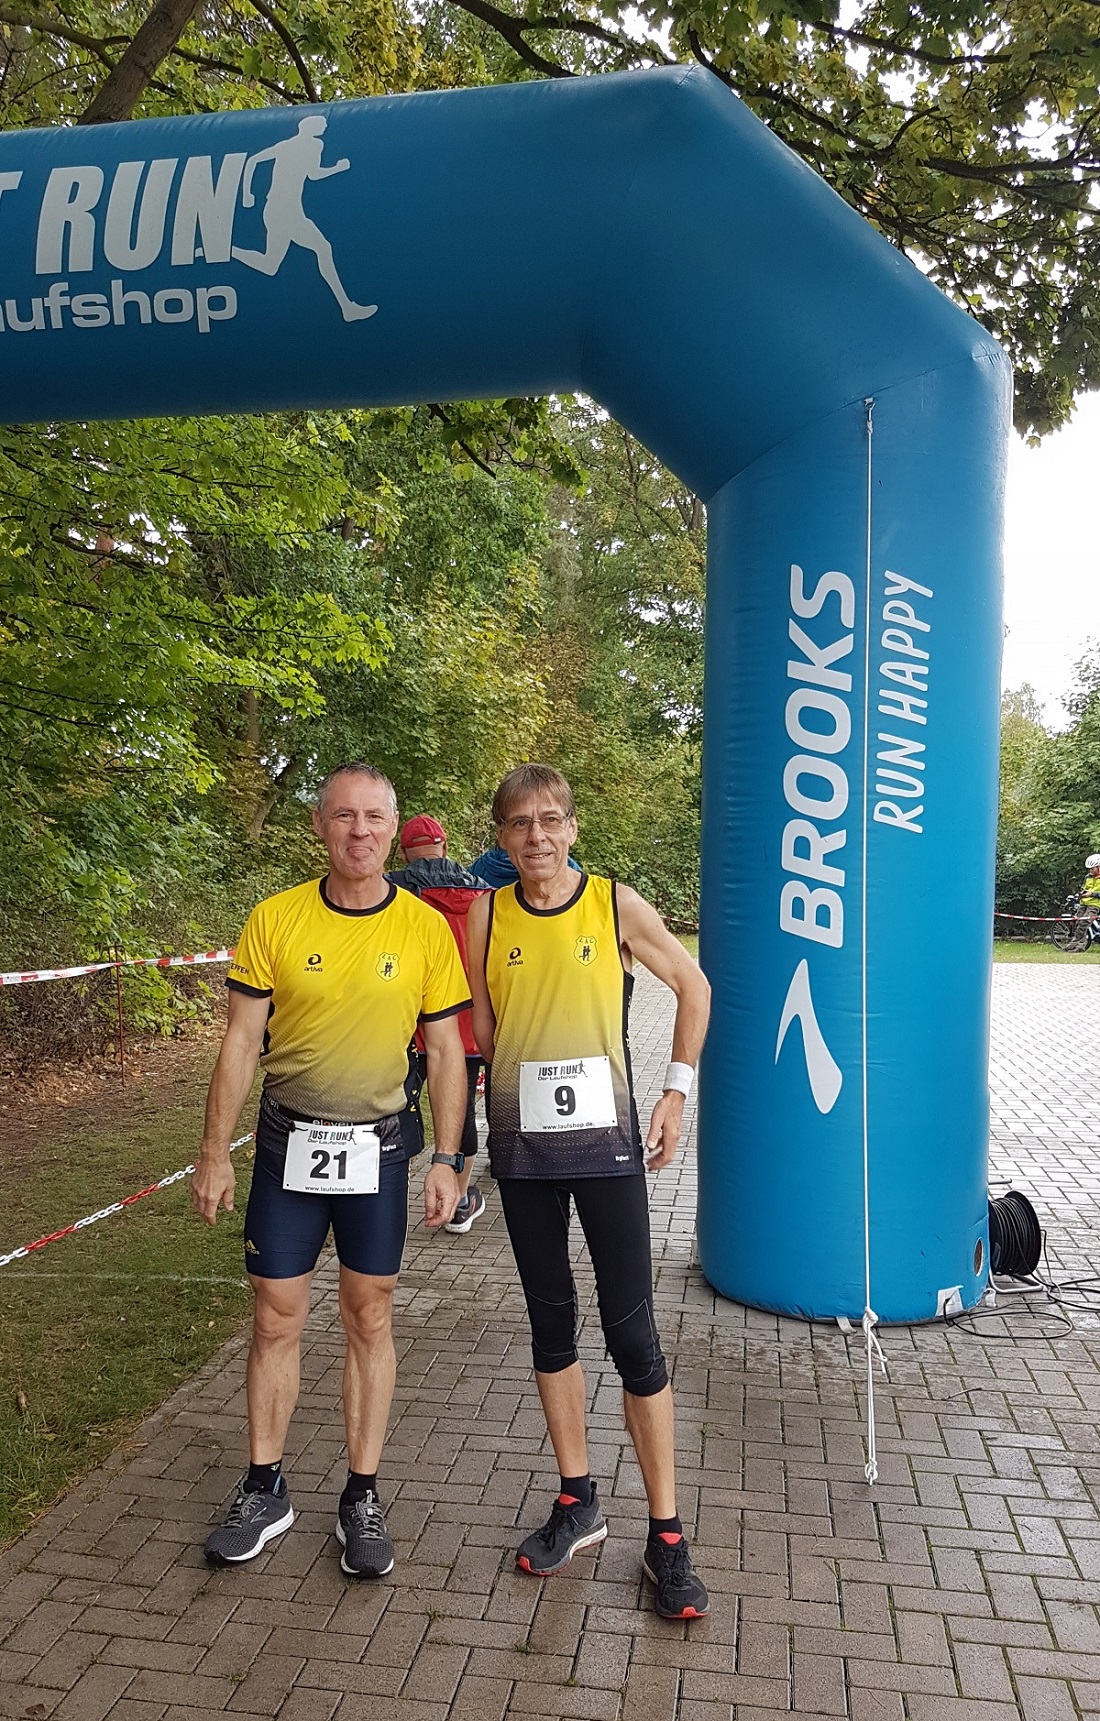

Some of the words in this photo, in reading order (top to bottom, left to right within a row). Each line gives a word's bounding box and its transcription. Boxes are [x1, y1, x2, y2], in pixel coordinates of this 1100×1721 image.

[36, 152, 247, 275] RUN
[0, 279, 238, 334] ufshop
[877, 569, 934, 725] HAPPY
[779, 564, 856, 949] BROOKS
[872, 732, 927, 834] RUN
[229, 963, 250, 975] EFFEN
[538, 1066, 559, 1077] JUST
[560, 1064, 579, 1076] RUN
[554, 1085, 576, 1117] 9
[308, 1129, 328, 1141] JUST
[329, 1131, 349, 1141] RUN
[542, 1121, 593, 1131] www.laufshop.de
[309, 1149, 348, 1180] 21
[304, 1185, 355, 1193] www.laufshop.de
